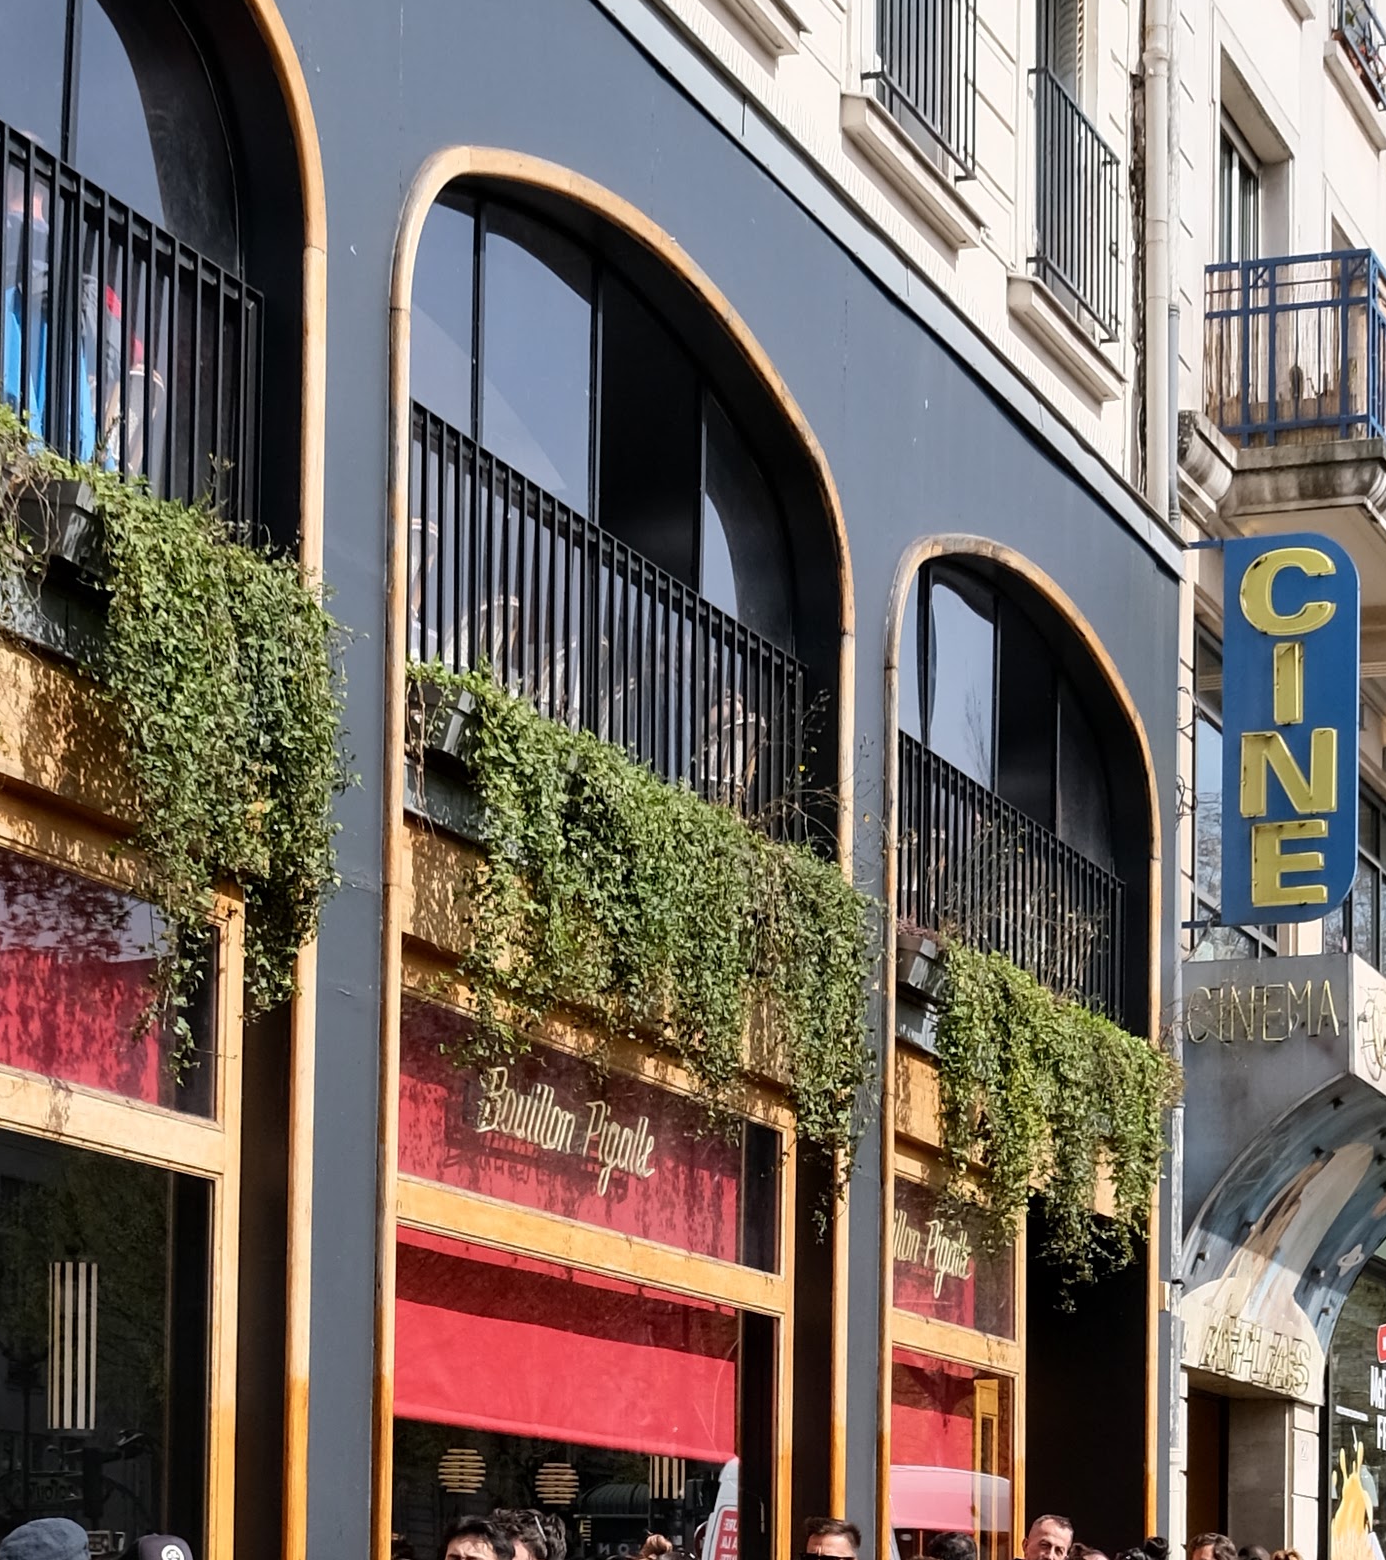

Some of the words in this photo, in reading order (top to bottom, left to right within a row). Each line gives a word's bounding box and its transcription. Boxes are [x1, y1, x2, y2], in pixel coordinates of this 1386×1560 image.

[1239, 547, 1338, 907] CINE
[1186, 979, 1340, 1044] CINEMA
[476, 1066, 576, 1155] Bouillon
[583, 1100, 656, 1197] Pigalle
